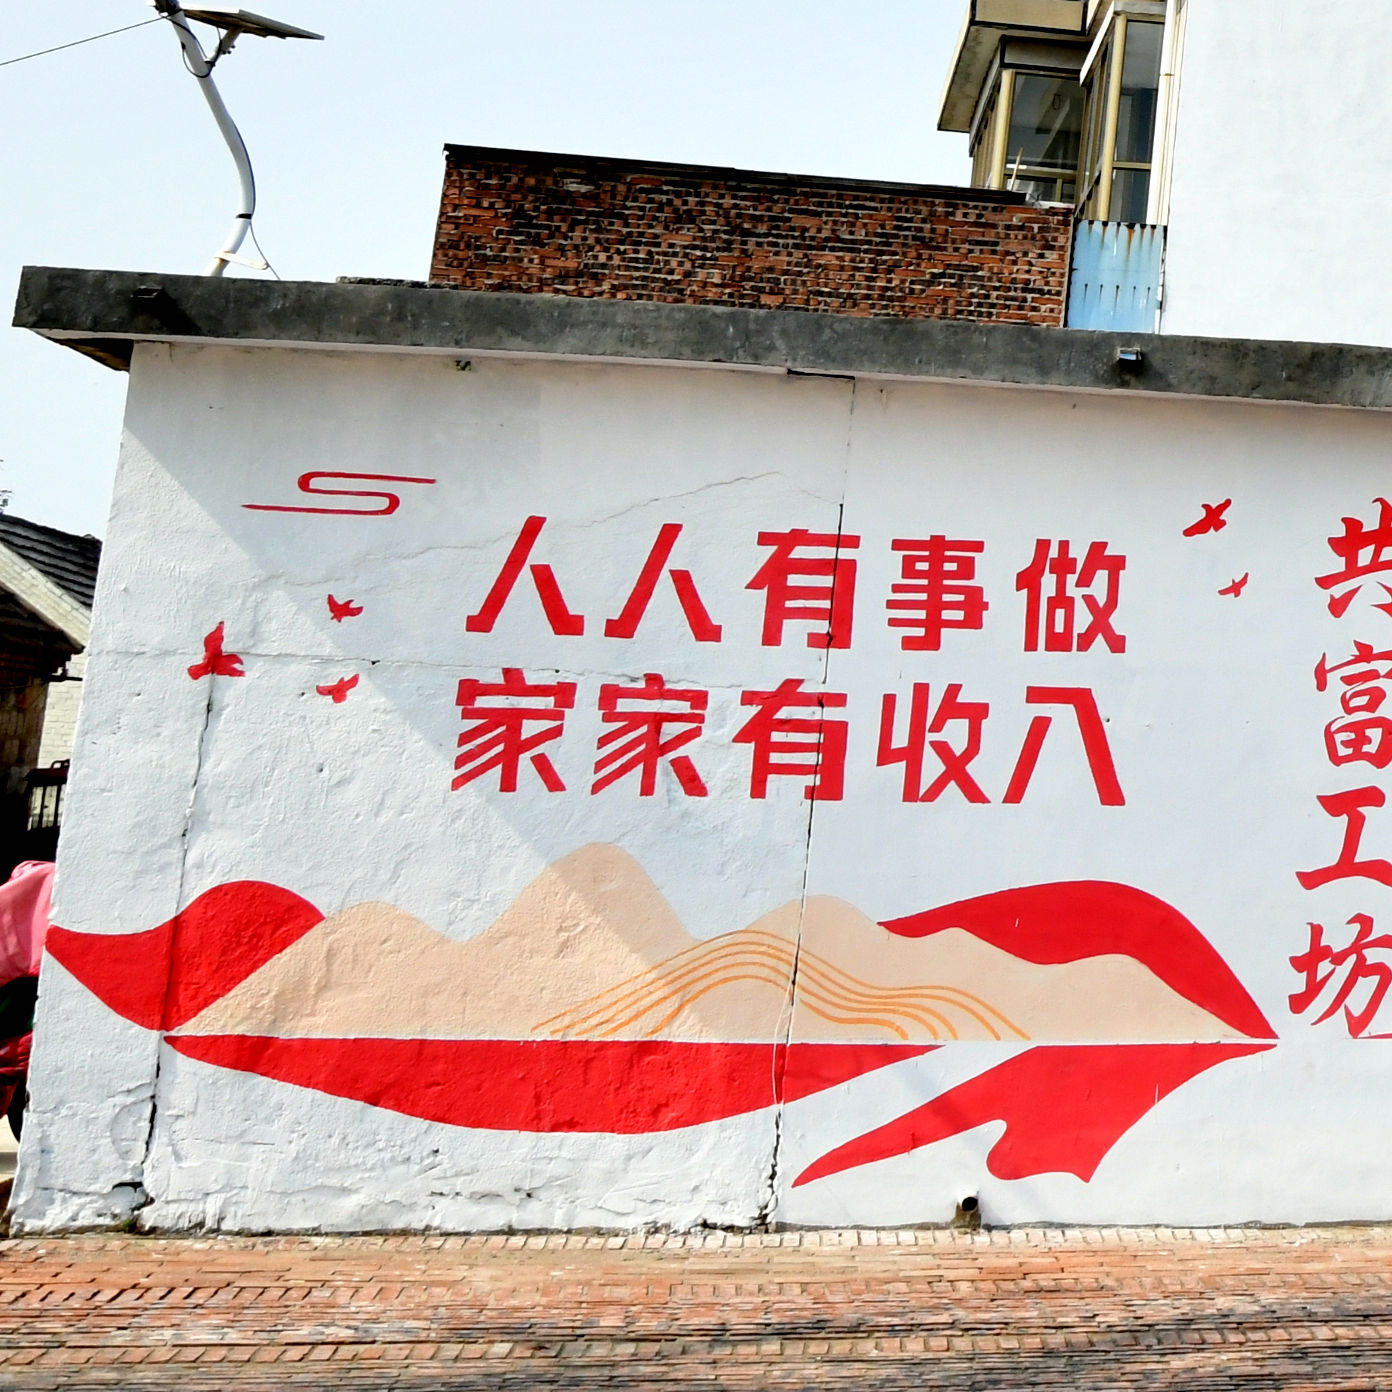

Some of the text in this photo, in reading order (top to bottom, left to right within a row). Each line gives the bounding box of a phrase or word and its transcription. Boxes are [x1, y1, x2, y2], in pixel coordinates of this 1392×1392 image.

[466, 515, 1127, 654] 人人有事做
[451, 667, 1126, 807] 家家有收入
